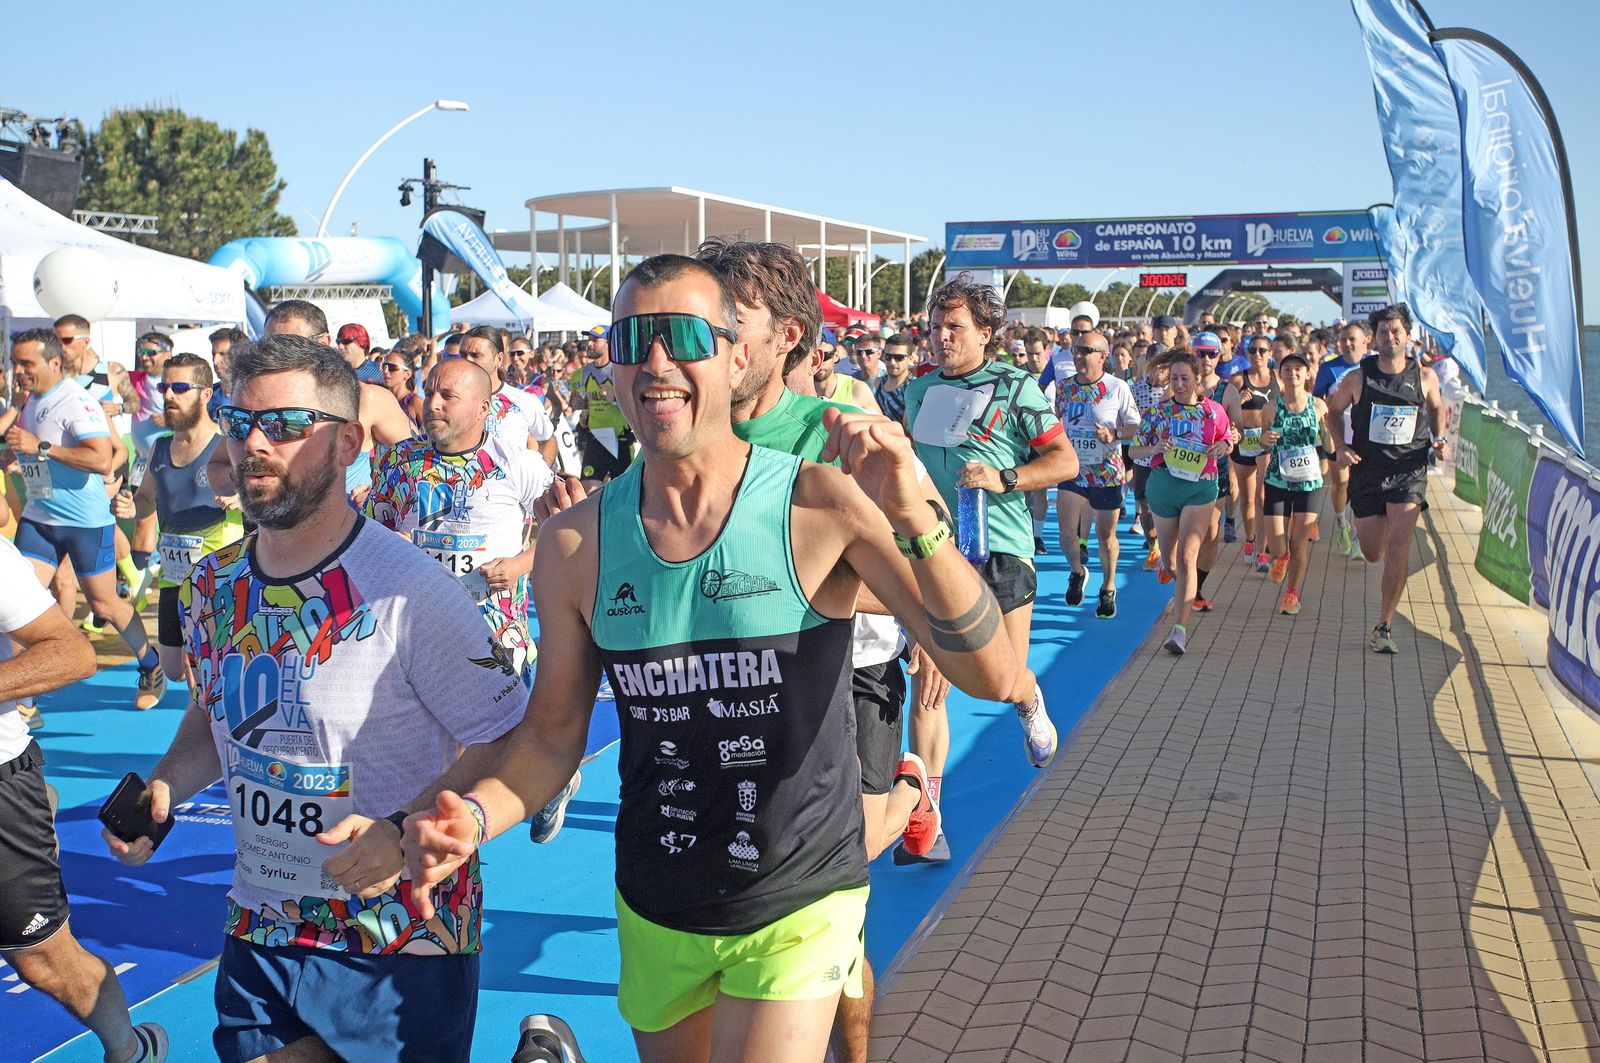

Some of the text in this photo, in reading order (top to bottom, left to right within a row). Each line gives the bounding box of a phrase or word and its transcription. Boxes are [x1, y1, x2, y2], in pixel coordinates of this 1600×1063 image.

[1095, 221, 1196, 237] CAMPEONATO
[1271, 228, 1314, 242] HUELVA
[1094, 233, 1233, 252] de ESPAÑA 10 km
[1131, 255, 1141, 263] en
[1144, 254, 1159, 263] ruta
[1161, 251, 1194, 262] Absoluto
[1204, 249, 1232, 261] Master
[1383, 416, 1406, 428] 727
[1072, 439, 1097, 451] 1196
[1173, 448, 1201, 465] 1904
[1289, 457, 1311, 469] 826
[457, 539, 480, 549] 2023
[162, 547, 192, 565] 1411
[607, 604, 647, 617] austral
[613, 648, 783, 698] ENCHATERA
[222, 653, 281, 734] 10
[720, 692, 781, 719] MASIÁ
[669, 706, 691, 722] BAR
[279, 734, 317, 747] PUERTA DEL
[731, 749, 767, 760] mediación
[293, 772, 336, 791] 2023
[236, 783, 324, 838] 1048
[255, 834, 290, 850] SERGIO
[268, 847, 312, 865] ANTONIO
[259, 864, 298, 882] Syrluz
[22, 918, 49, 936] adidas
